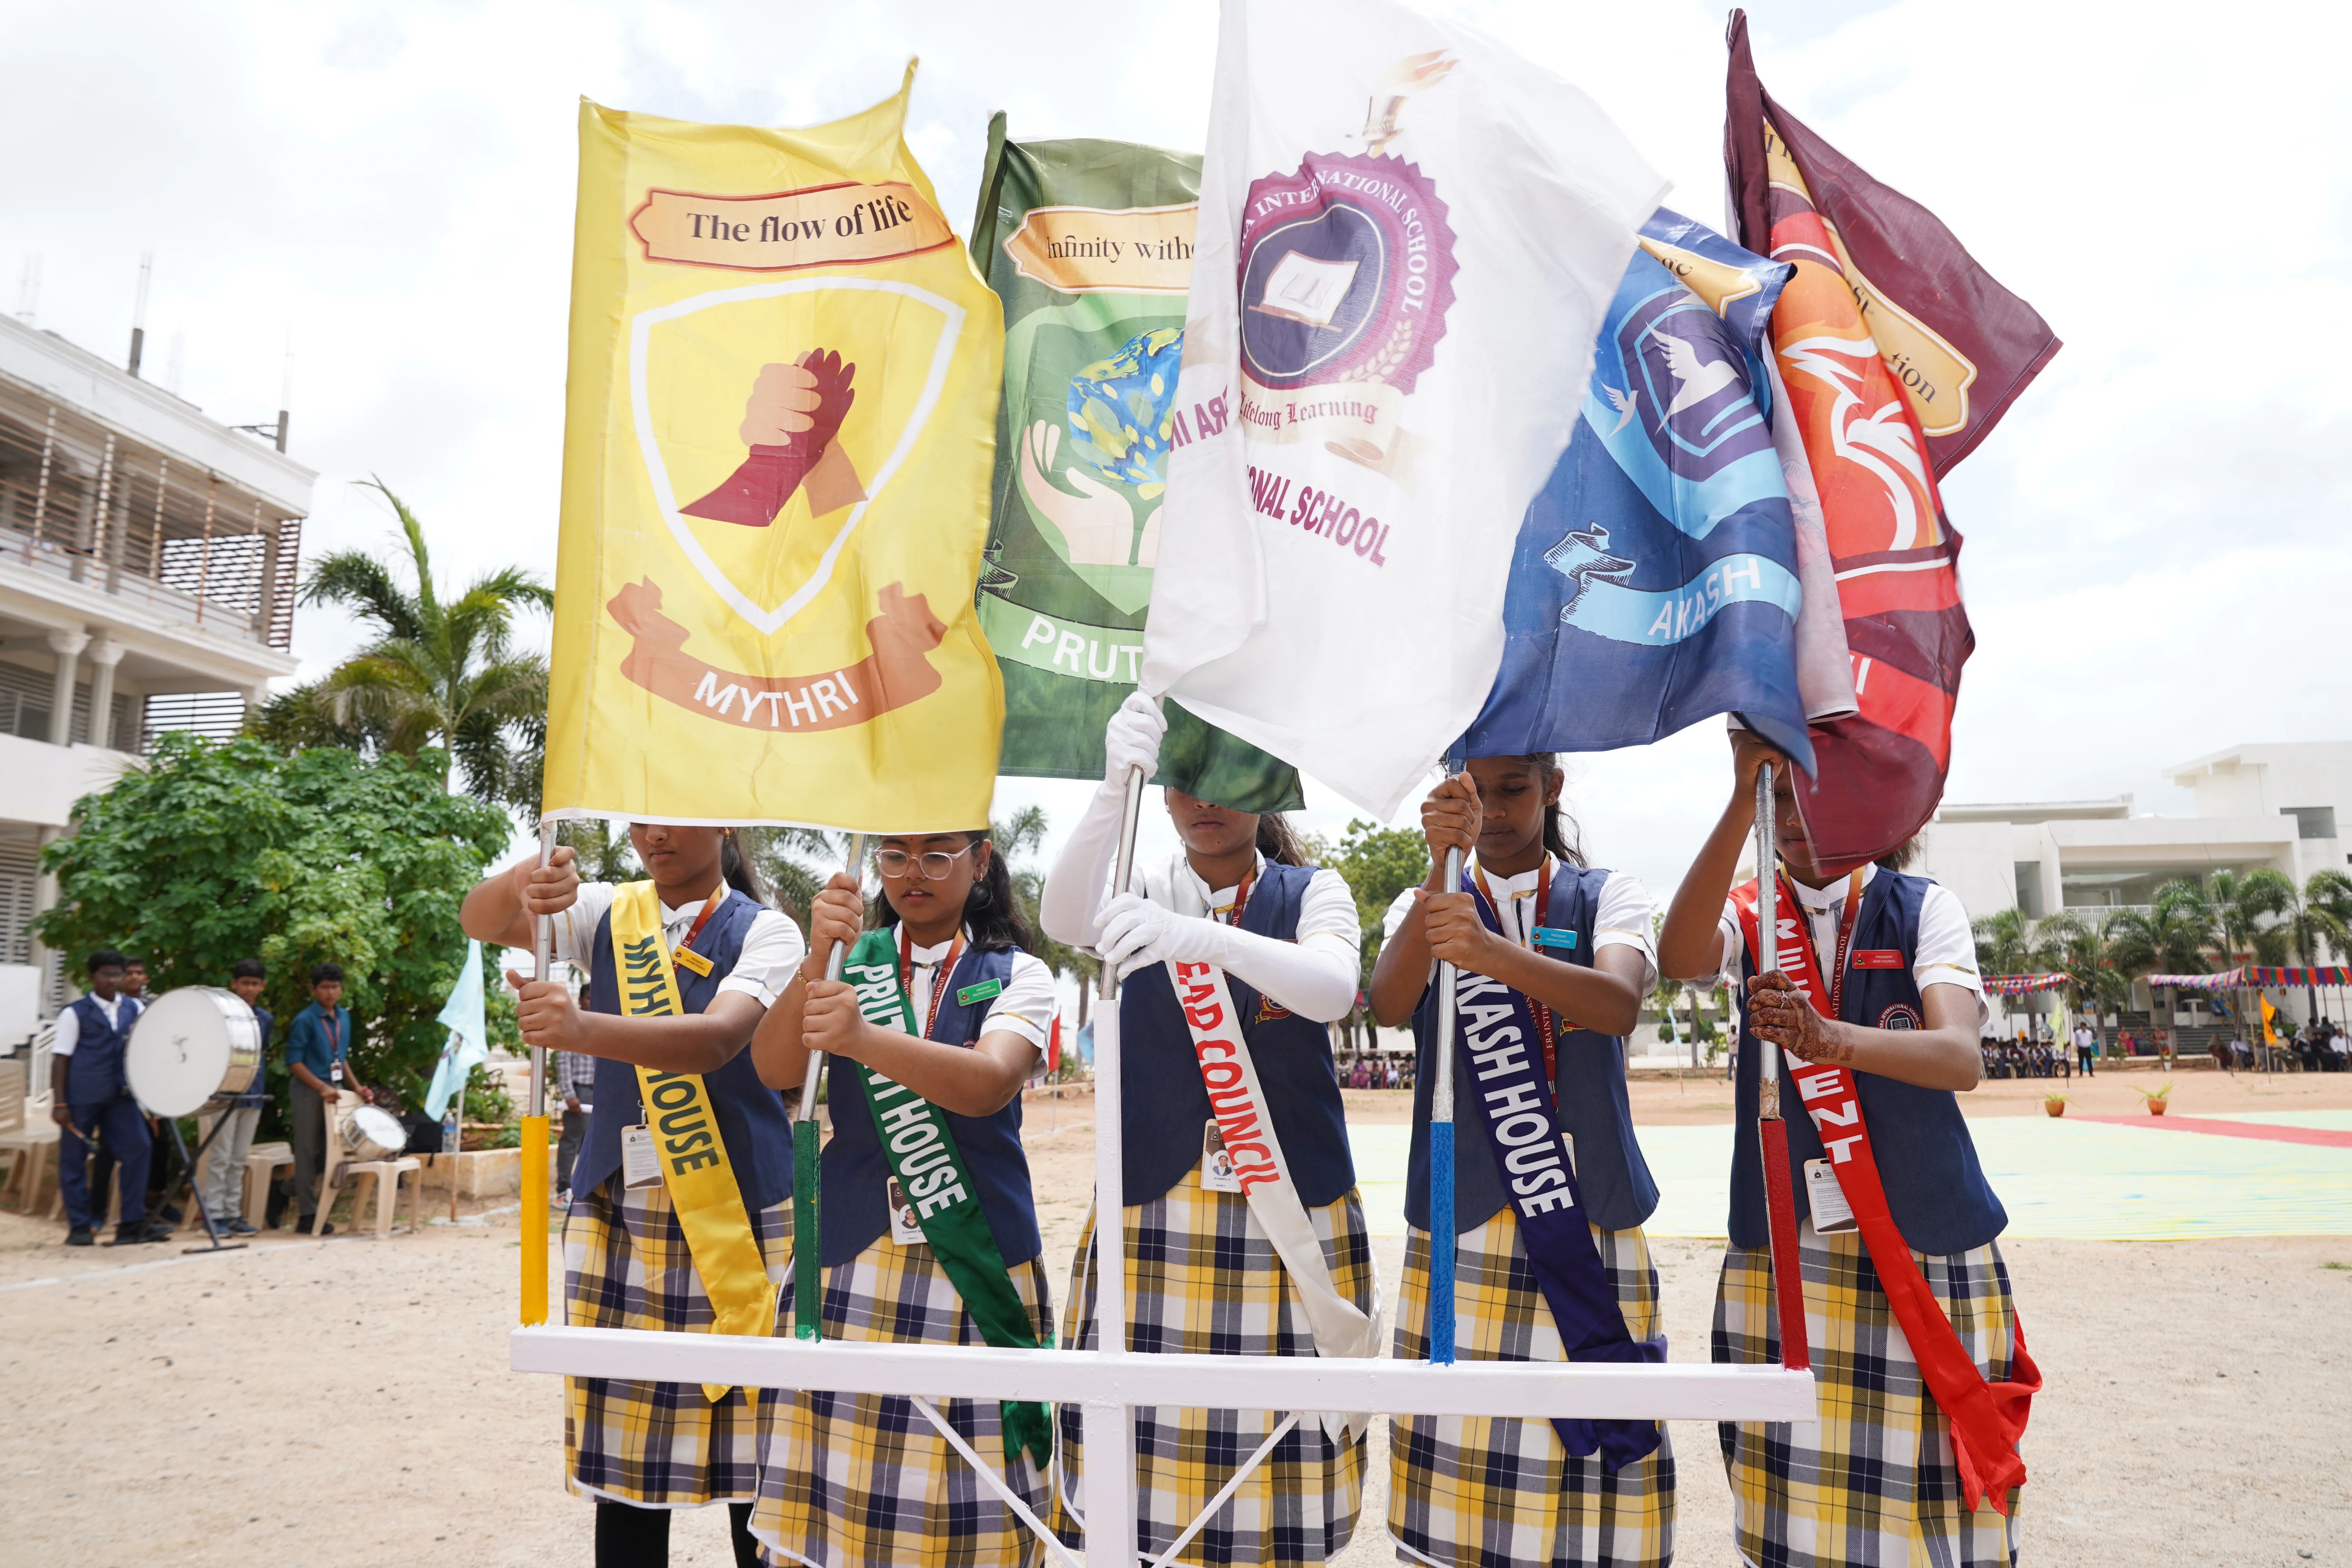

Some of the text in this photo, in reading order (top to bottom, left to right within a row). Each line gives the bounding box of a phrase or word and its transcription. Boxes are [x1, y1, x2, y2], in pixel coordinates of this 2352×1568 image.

[687, 194, 913, 242] The flow of life
[1047, 235, 1125, 263] Infinity
[1256, 171, 1406, 217] INTERNATIONAL
[1401, 208, 1427, 313] SCHOOL
[1286, 396, 1379, 425] Learning
[1290, 486, 1390, 566] SCHOOL
[1648, 558, 1761, 639] AKASH
[693, 670, 859, 727] MYTHRI
[1837, 934, 1847, 971] SCHOOL
[933, 976, 947, 1006] SCHOOL
[1175, 961, 1223, 1031] EAD
[1881, 1004, 1908, 1020] INTERNATIONAL
[1909, 1008, 1920, 1023] SCHOOL
[1196, 1039, 1280, 1197] COUNCIL
[1484, 1081, 1575, 1218] HOUSE
[880, 1098, 967, 1220] HOUSE
